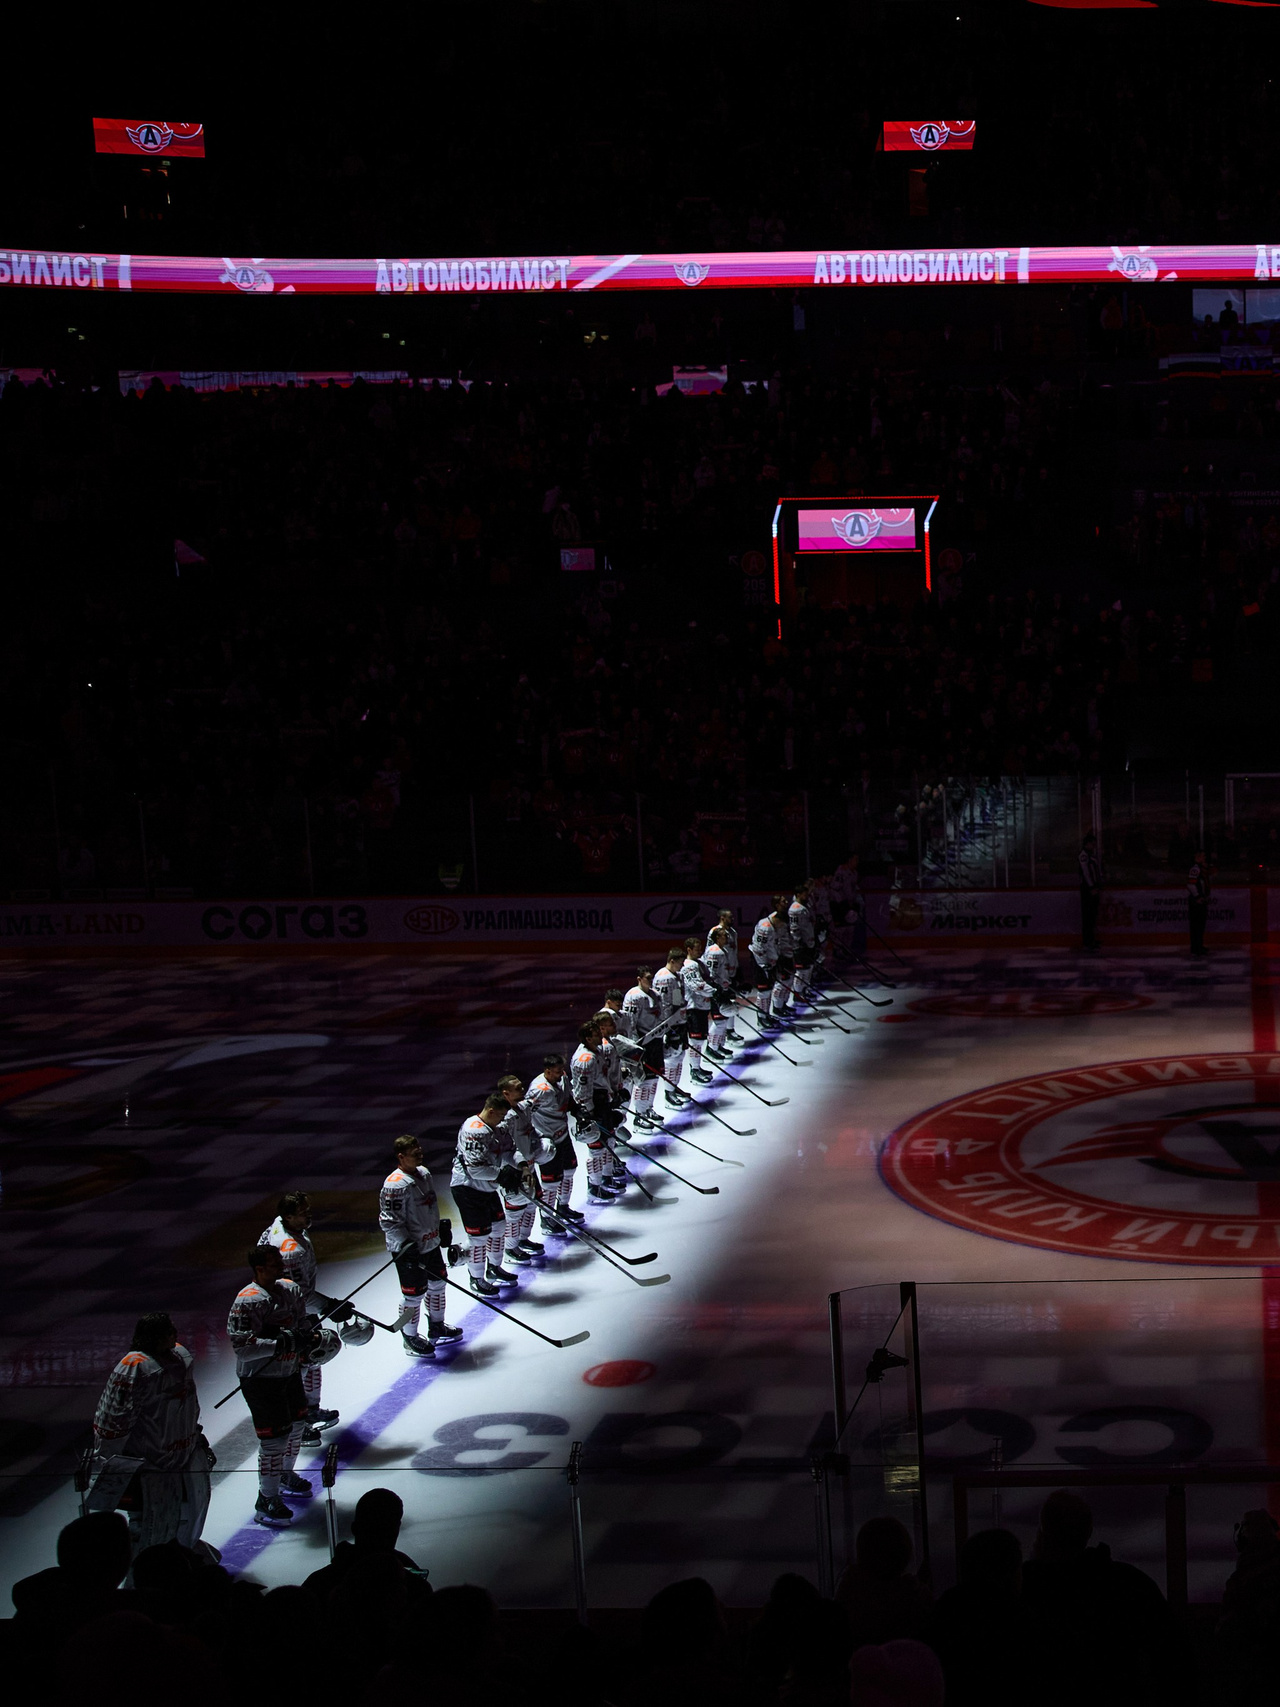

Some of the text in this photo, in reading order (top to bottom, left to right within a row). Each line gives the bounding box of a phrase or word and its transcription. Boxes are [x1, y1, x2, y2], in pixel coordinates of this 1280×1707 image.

[375, 259, 570, 292] АВТОМОБИЛИСТ
[814, 251, 1009, 284] АВТОМОБИЛИСТ
[0, 913, 145, 936] MA-LAND
[463, 909, 614, 932] УРАЛМАШЗАВОД
[930, 915, 1032, 931] Маркет
[465, 1142, 484, 1152] 44
[939, 1172, 1108, 1232] КЛУБ
